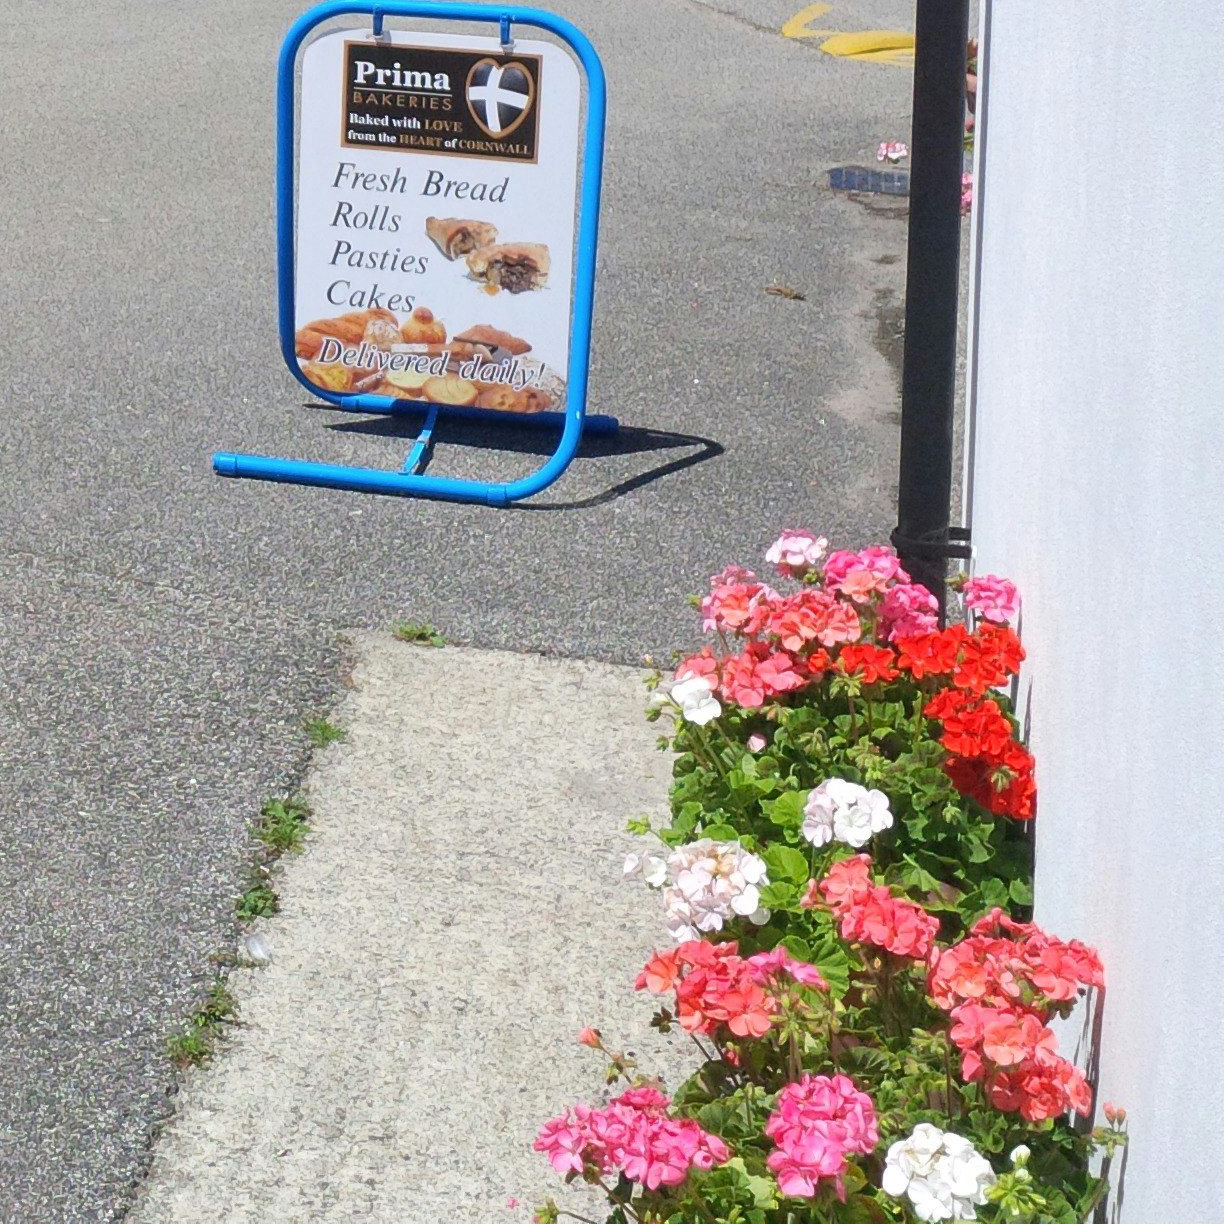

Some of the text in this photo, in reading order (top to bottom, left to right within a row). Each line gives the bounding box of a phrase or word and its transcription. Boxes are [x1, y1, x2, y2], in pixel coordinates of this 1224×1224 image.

[353, 60, 451, 91] Prima
[353, 91, 453, 111] BAKERIES
[349, 112, 464, 133] Baked with LOVE
[348, 129, 532, 156] from the HEART of CORNWALL
[332, 162, 510, 204] Fresh Bread
[330, 200, 402, 233] Rolls
[329, 239, 429, 275] Pasties
[326, 279, 416, 313] Cakes
[318, 338, 547, 391] Delivered daily!
